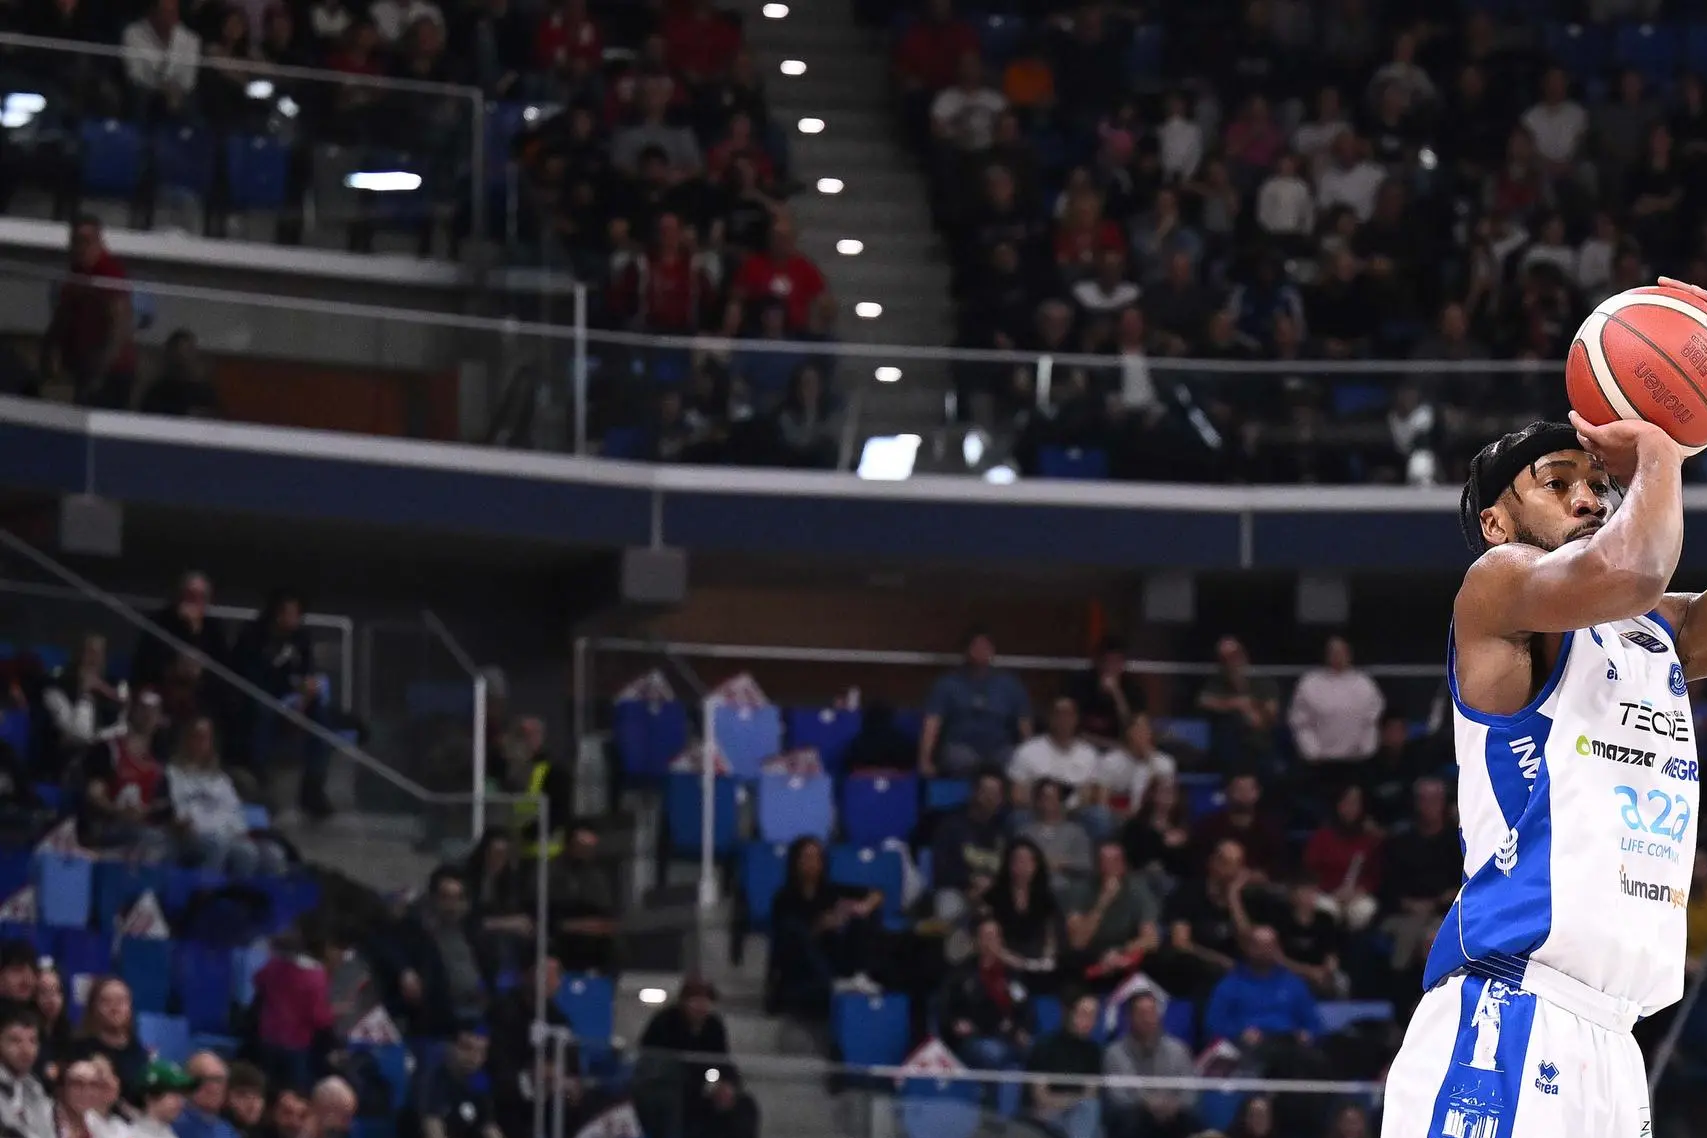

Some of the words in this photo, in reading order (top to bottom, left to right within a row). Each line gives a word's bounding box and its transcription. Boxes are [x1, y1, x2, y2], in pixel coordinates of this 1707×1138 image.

[1634, 360, 1695, 425] molten
[1591, 739, 1657, 768] mazza
[1620, 837, 1645, 854] LIFE
